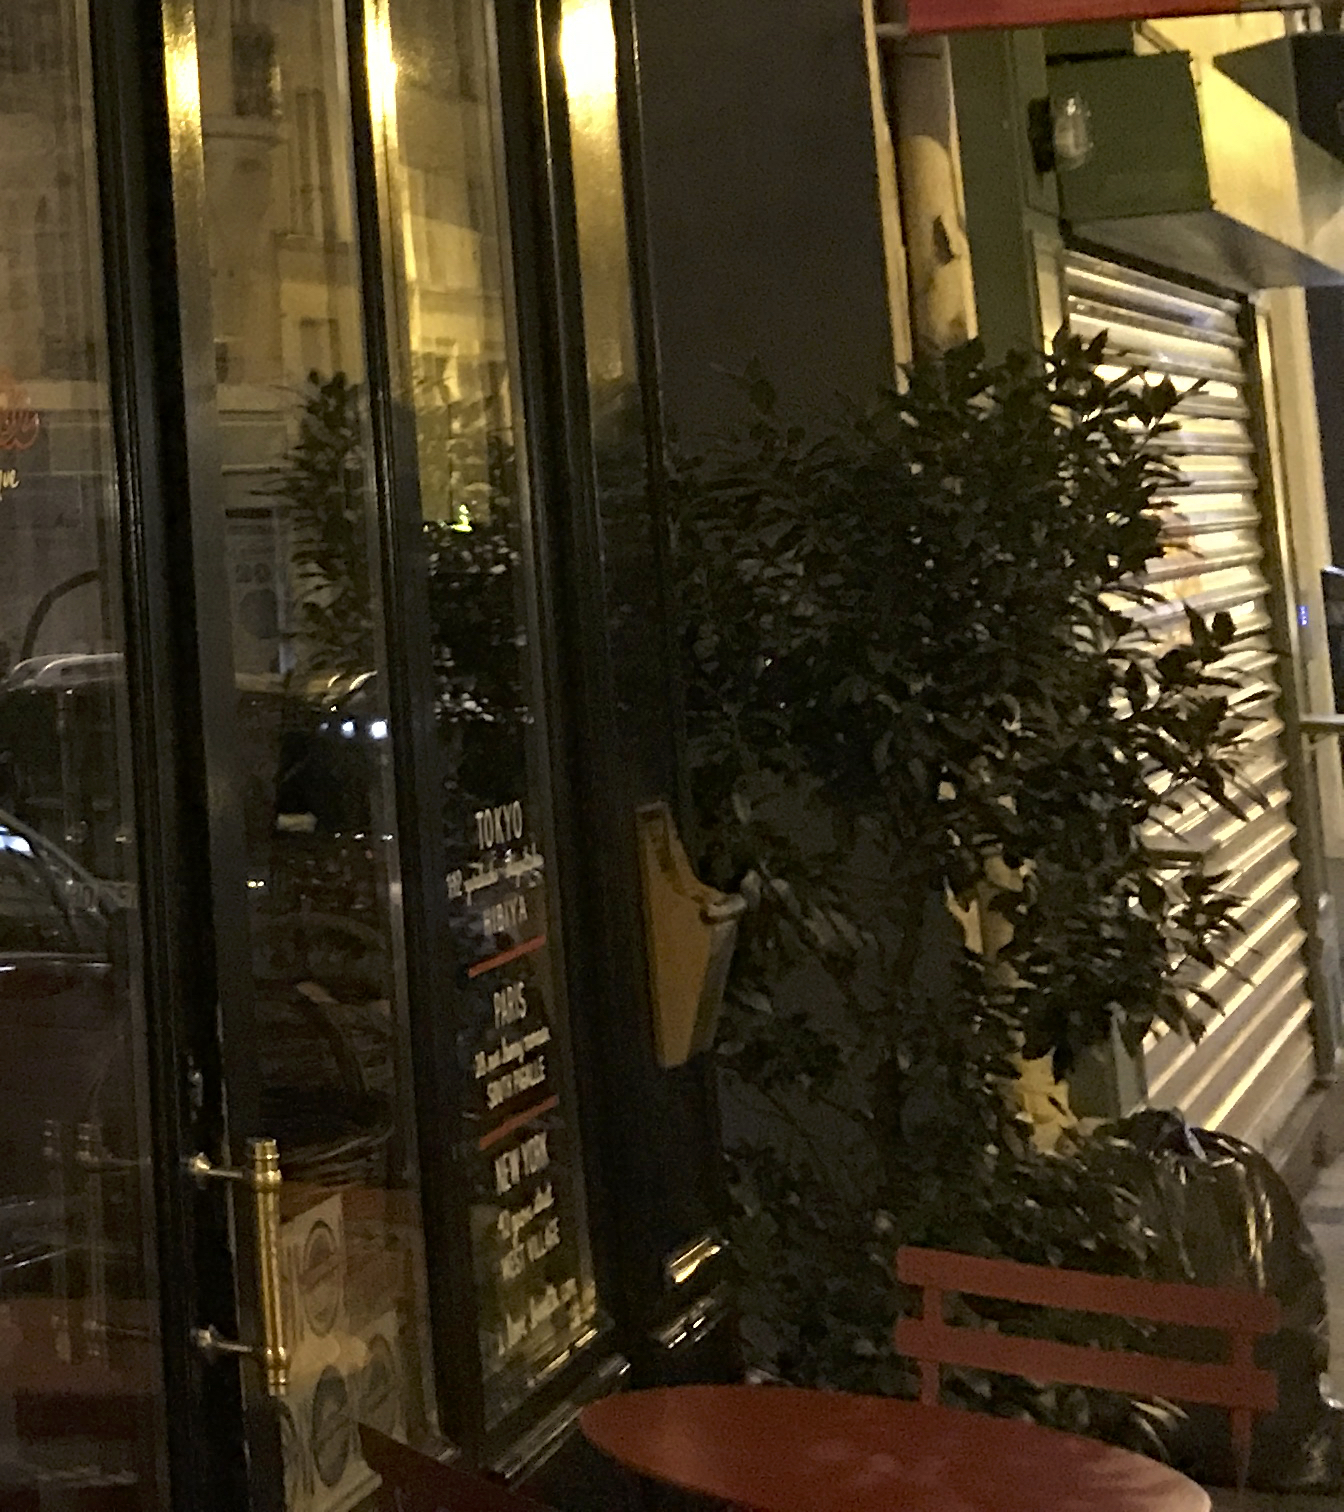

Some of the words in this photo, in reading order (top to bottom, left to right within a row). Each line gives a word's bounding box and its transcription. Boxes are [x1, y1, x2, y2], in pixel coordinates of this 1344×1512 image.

[474, 800, 523, 851] TOKYO
[493, 981, 527, 1029] PARIS
[494, 1148, 521, 1196] NEW
